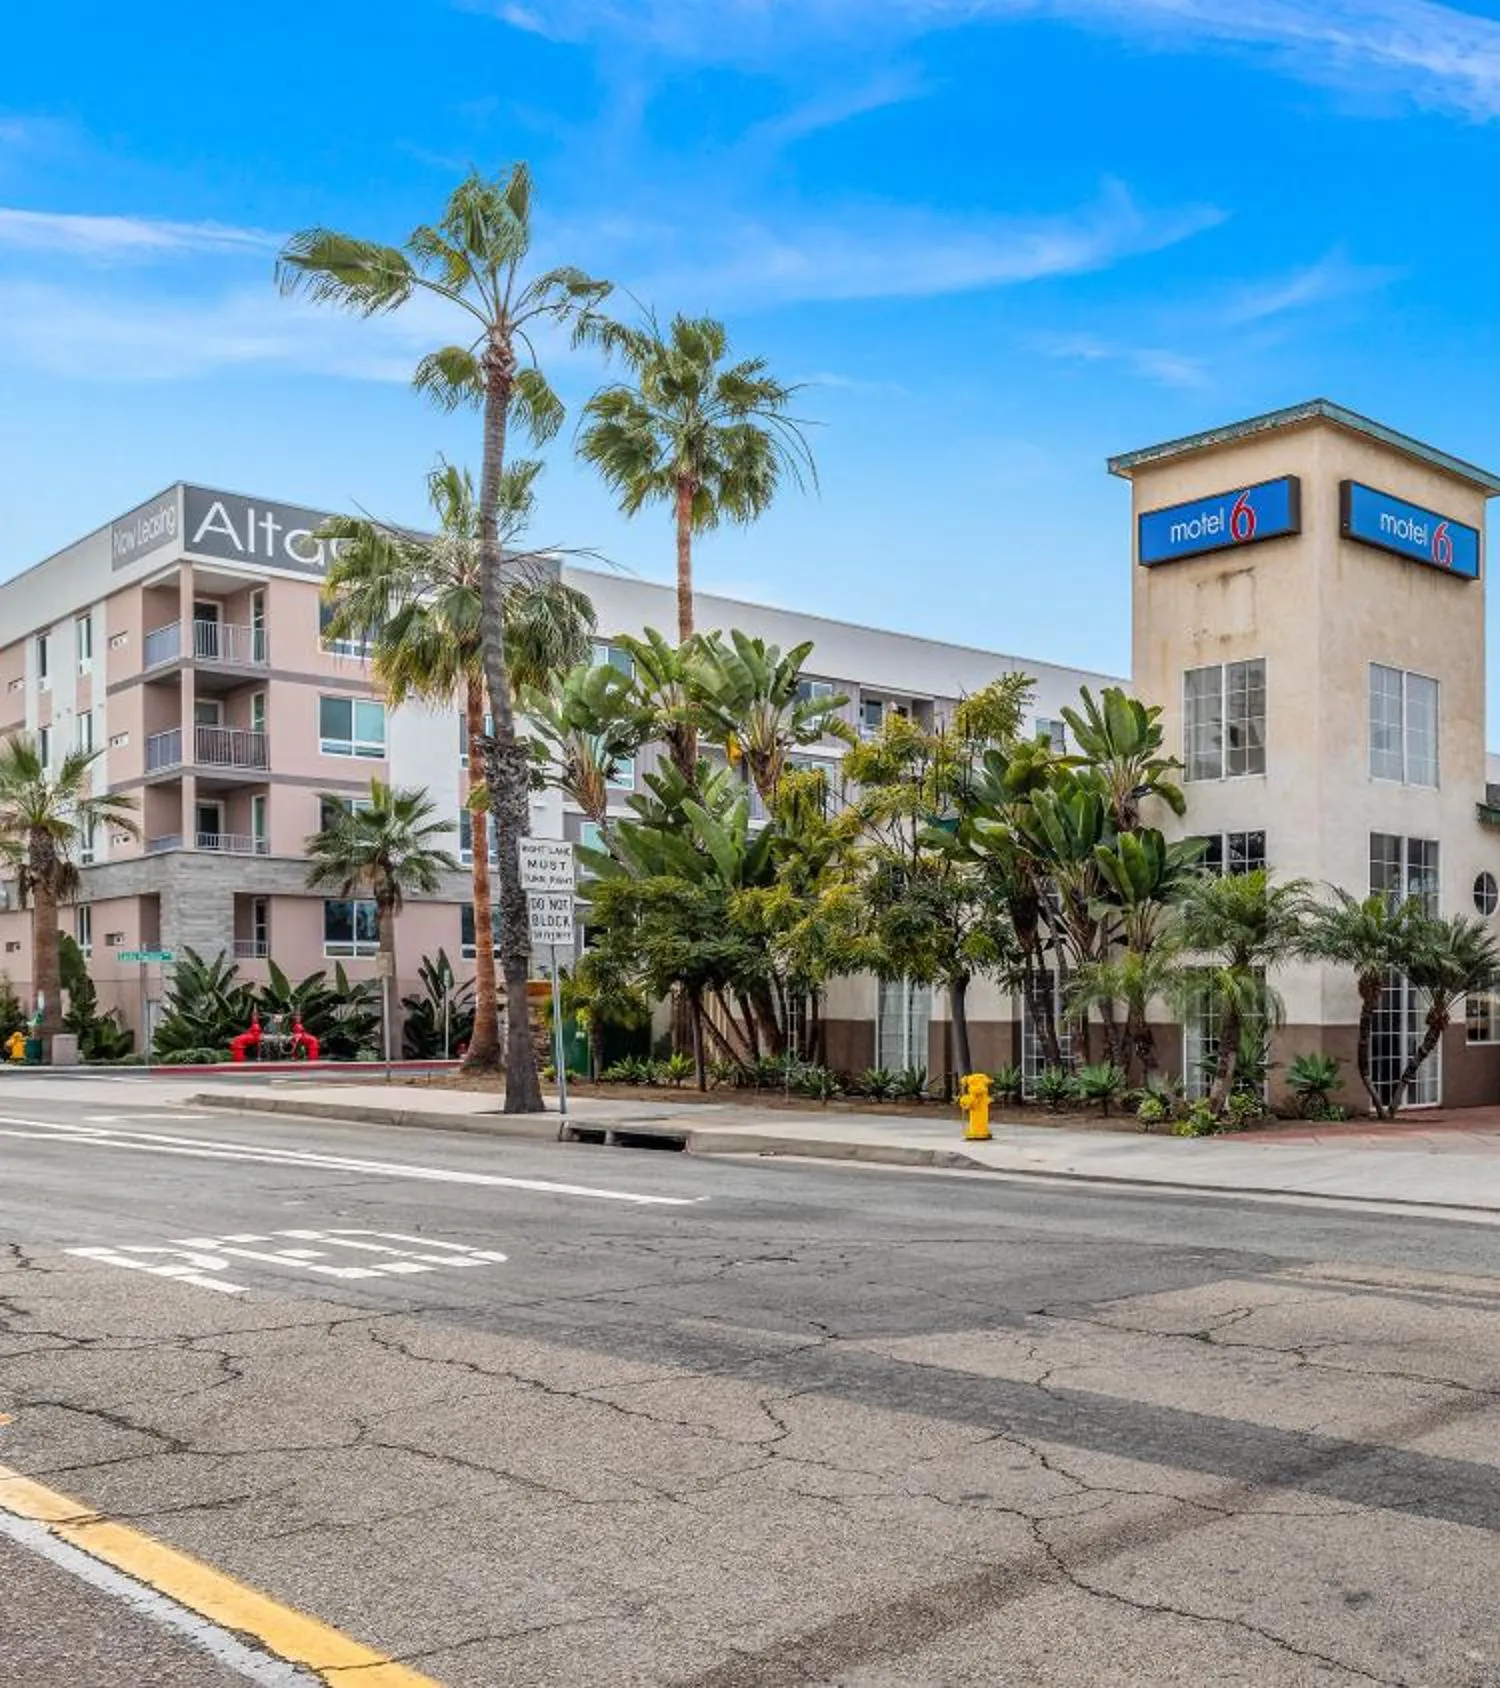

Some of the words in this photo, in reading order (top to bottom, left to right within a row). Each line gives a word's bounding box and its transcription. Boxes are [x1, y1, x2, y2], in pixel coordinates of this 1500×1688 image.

[1170, 508, 1225, 543] motel
[1229, 489, 1257, 542] 6
[113, 526, 136, 557] Now
[137, 505, 176, 546] Leasing
[1380, 512, 1428, 547] motel
[1431, 521, 1453, 567] 6
[548, 846, 571, 857] LANE
[527, 859, 567, 871] MUST
[531, 897, 545, 911] DO
[549, 898, 570, 911] NOT
[531, 914, 571, 928] BLOCK
